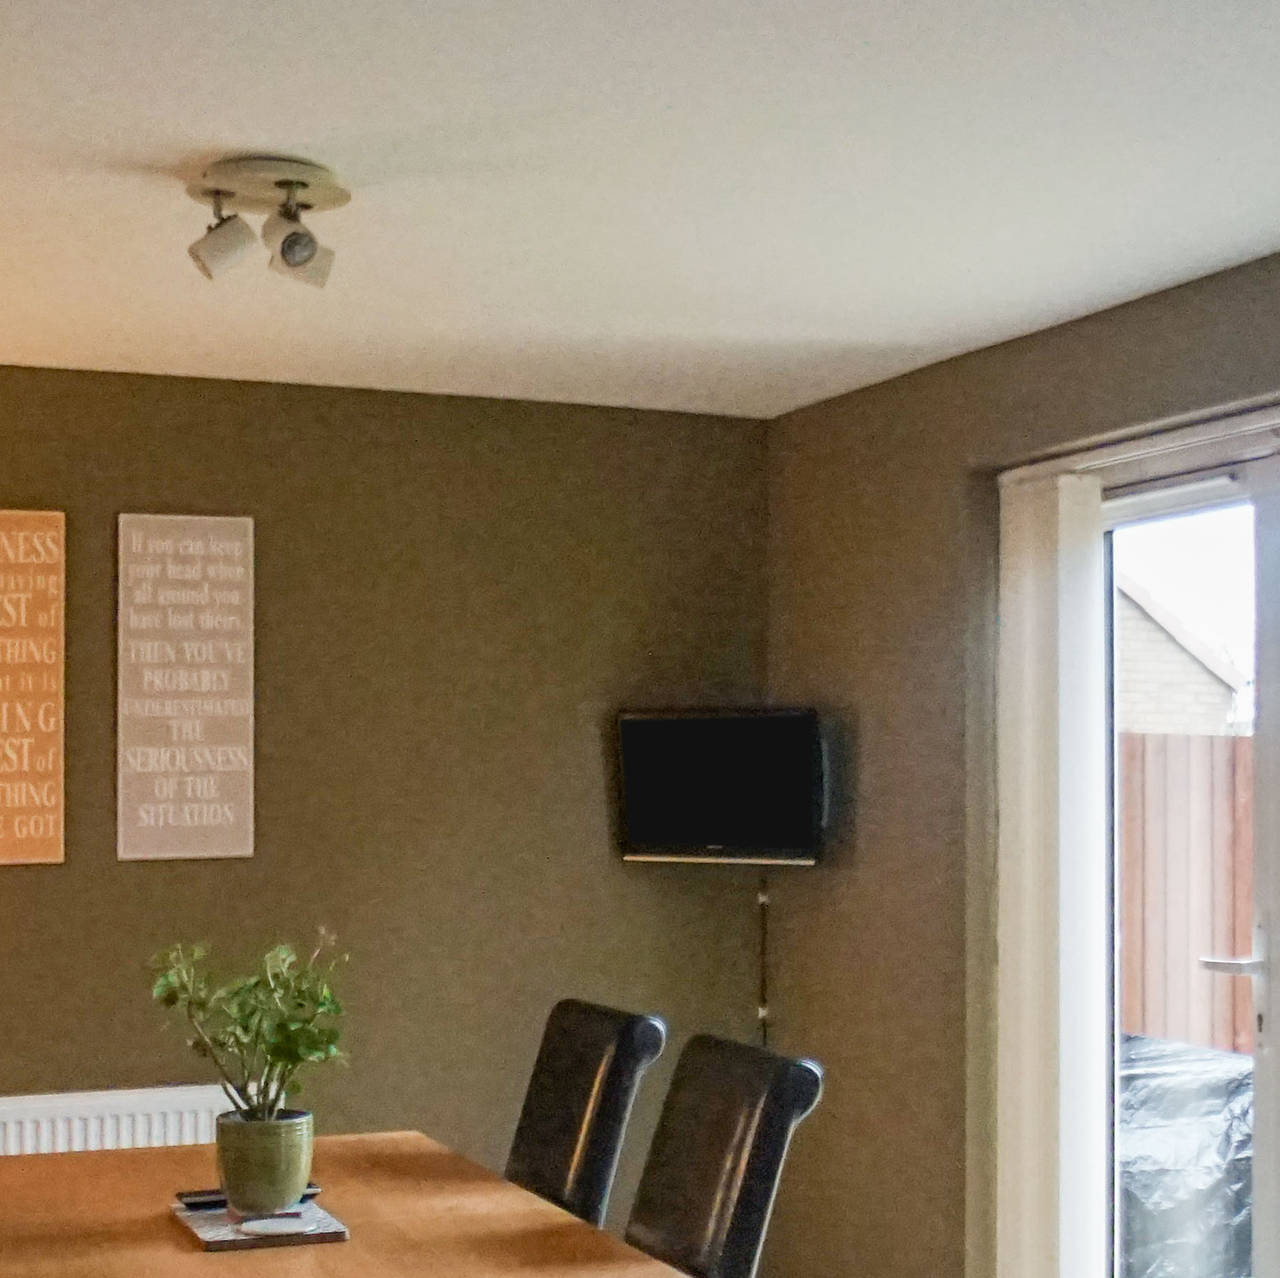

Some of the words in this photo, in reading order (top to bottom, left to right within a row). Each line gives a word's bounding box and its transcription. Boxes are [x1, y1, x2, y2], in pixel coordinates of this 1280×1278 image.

[37, 603, 58, 627] of
[36, 747, 57, 772] of
[14, 814, 57, 839] GOT
[136, 803, 234, 827] SITUATION
